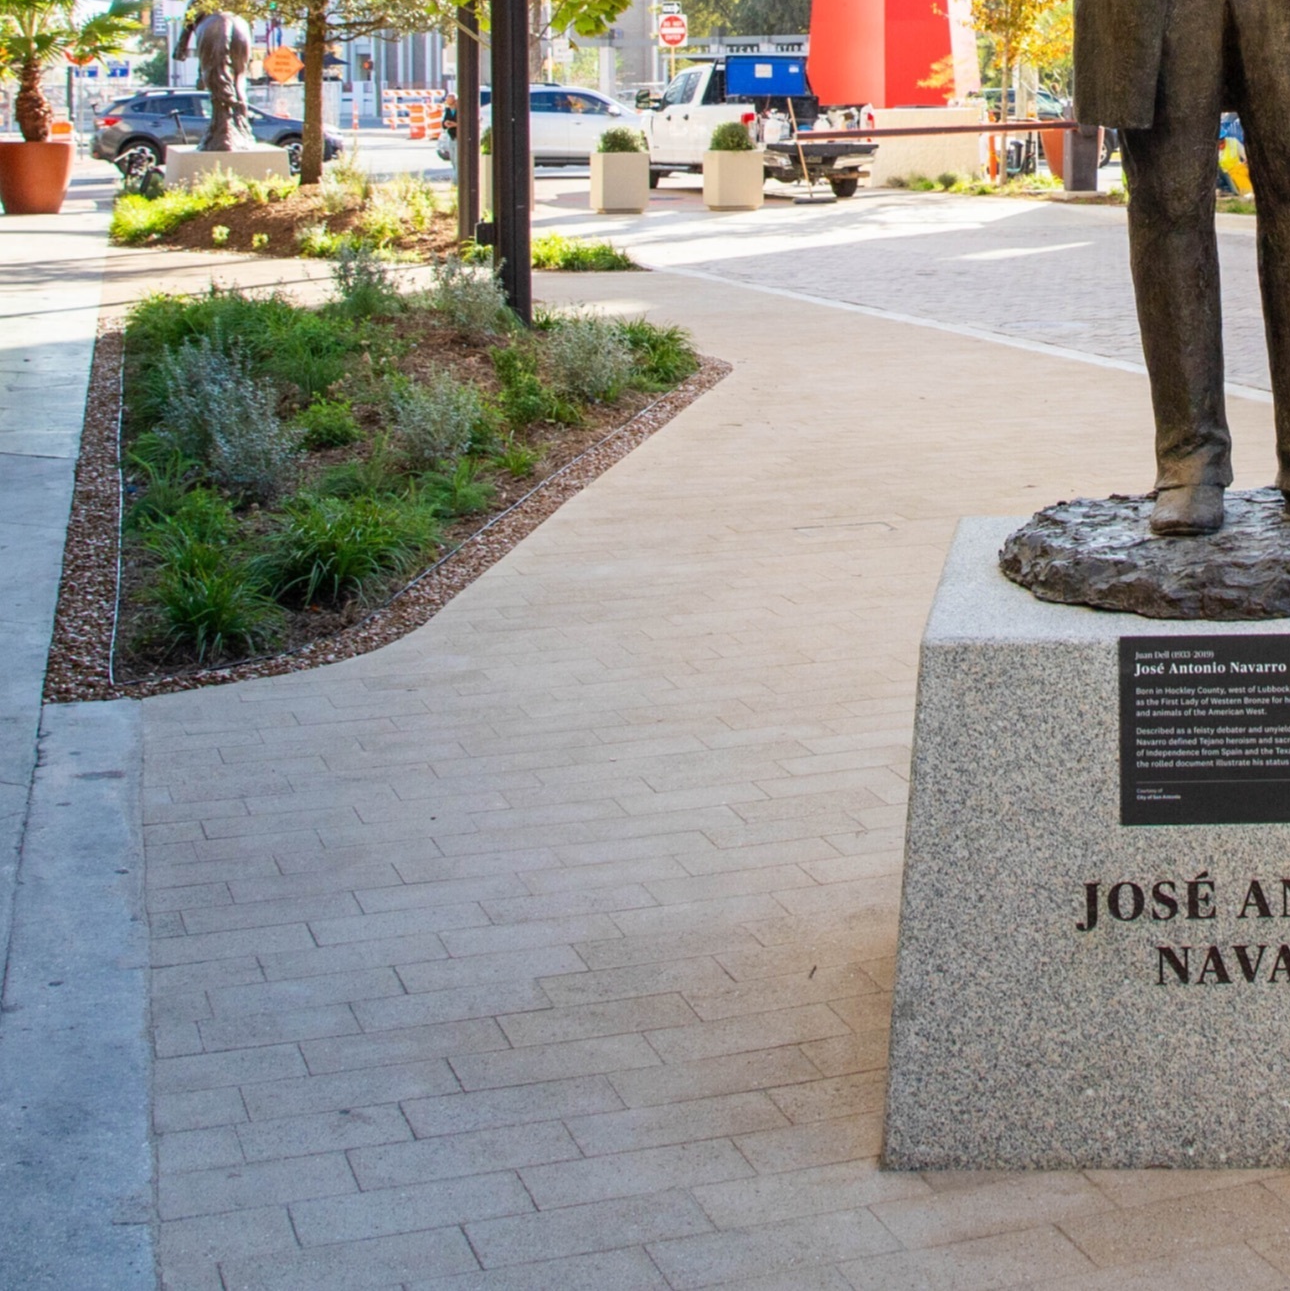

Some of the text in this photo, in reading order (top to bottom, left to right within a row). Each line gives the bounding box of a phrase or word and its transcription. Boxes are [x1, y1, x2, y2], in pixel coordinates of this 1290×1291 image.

[1133, 661, 1287, 676] José Antonio Navarro
[1164, 687, 1195, 695] Hockley
[1197, 686, 1226, 695] County,
[1247, 685, 1256, 693] of
[1180, 698, 1198, 706] Lady
[1243, 696, 1270, 704] Bronze
[1184, 708, 1191, 716] of
[1208, 708, 1244, 716] American
[1136, 727, 1174, 735] Described
[1193, 726, 1214, 735] feisty
[1168, 737, 1197, 745] defined
[1199, 737, 1224, 746] Tejano
[1226, 736, 1256, 744] heroism
[1146, 748, 1199, 758] Independence
[1221, 747, 1242, 756] Spain
[1244, 747, 1258, 755] and
[1175, 759, 1213, 767] document
[1252, 758, 1264, 766] his
[1076, 871, 1218, 932] JOSÉ
